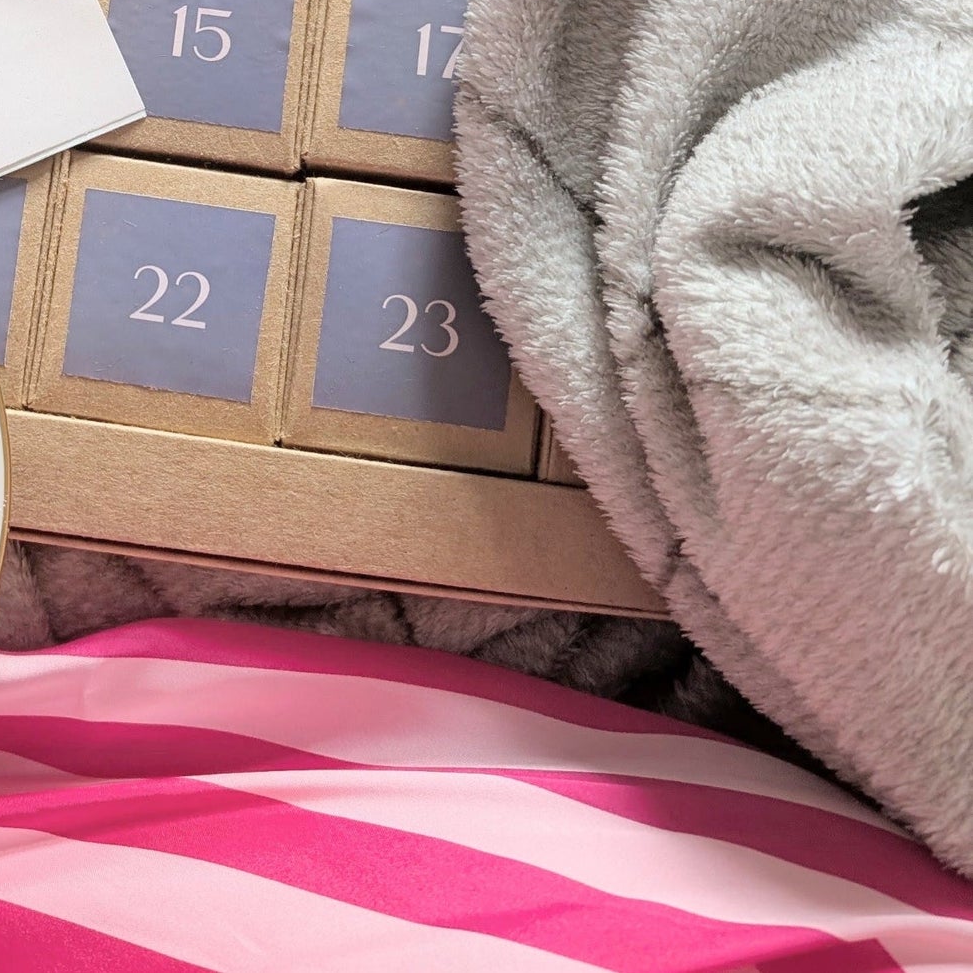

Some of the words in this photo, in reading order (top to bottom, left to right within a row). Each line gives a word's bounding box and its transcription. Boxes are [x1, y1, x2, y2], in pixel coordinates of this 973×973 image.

[171, 4, 233, 62] 15
[416, 23, 464, 79] 17
[129, 265, 211, 329] 22
[379, 295, 459, 357] 23
